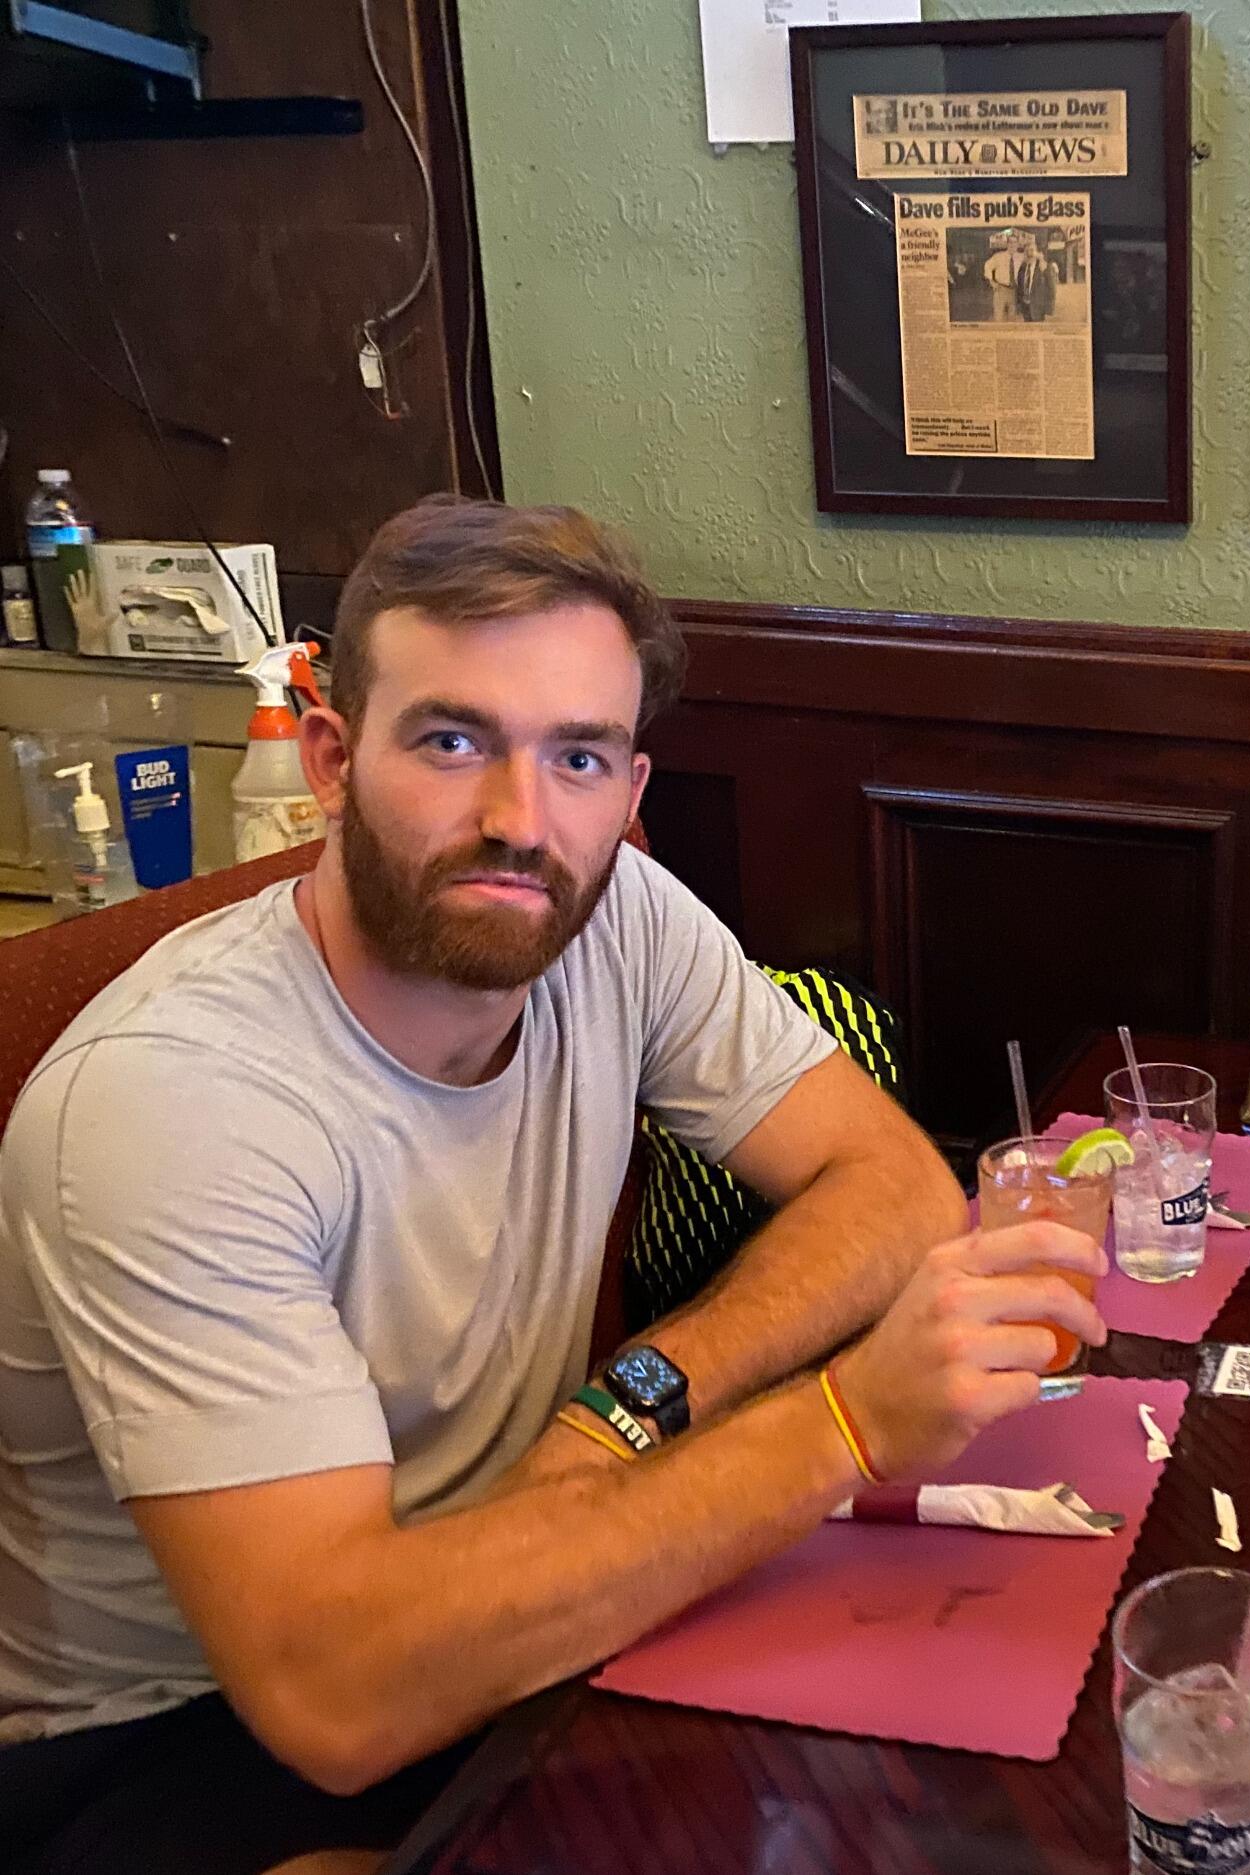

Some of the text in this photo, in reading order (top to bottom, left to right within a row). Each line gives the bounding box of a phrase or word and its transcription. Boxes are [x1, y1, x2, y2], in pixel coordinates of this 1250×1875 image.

[940, 100, 970, 118] THE
[977, 99, 1020, 117] SAME
[1027, 98, 1060, 116] OLD
[1067, 98, 1108, 116] DAVE
[883, 137, 1096, 166] DAILY NEWS
[900, 195, 1086, 223] Dave fills pub's glass
[136, 760, 170, 777] BUD
[131, 772, 177, 791] LIGHT
[1163, 1198, 1205, 1222] BLUE
